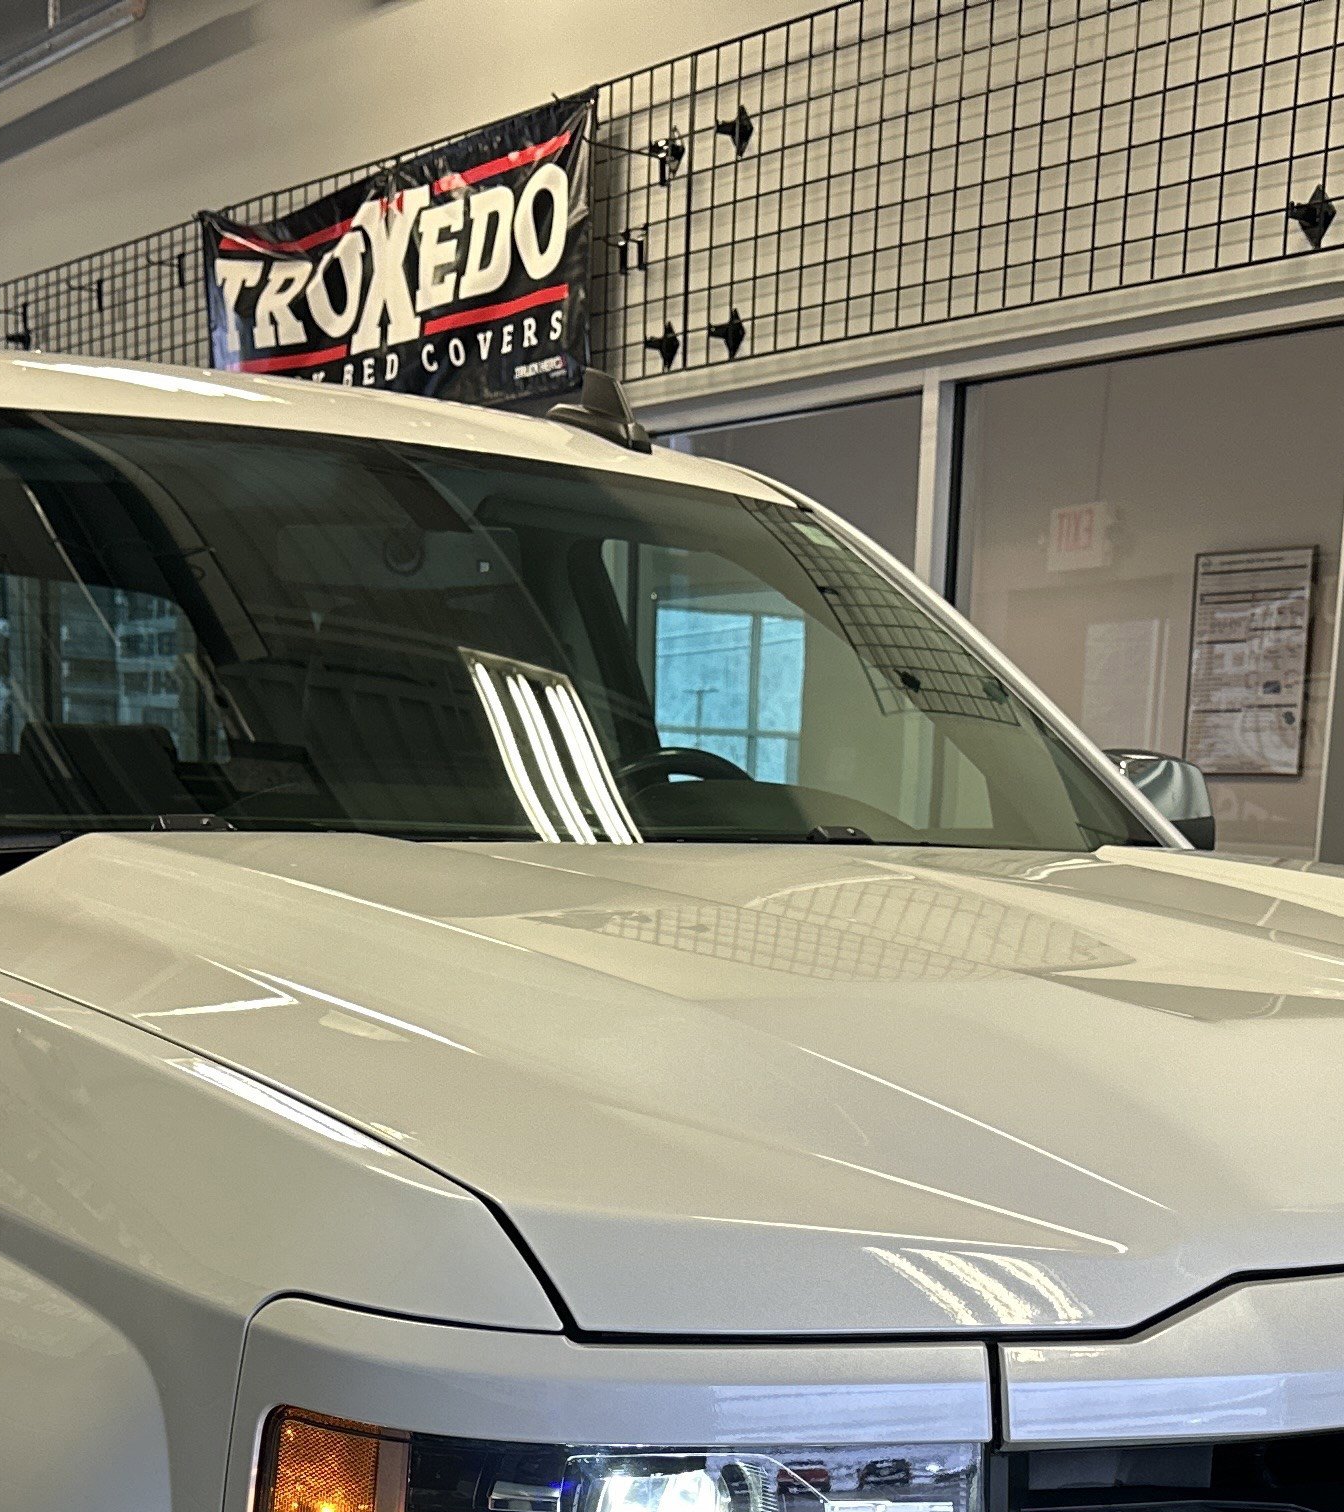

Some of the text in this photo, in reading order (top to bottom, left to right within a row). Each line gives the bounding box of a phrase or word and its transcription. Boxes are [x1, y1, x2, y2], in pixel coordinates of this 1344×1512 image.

[215, 163, 569, 354] TROXEDO
[343, 310, 563, 386] BED COVERS
